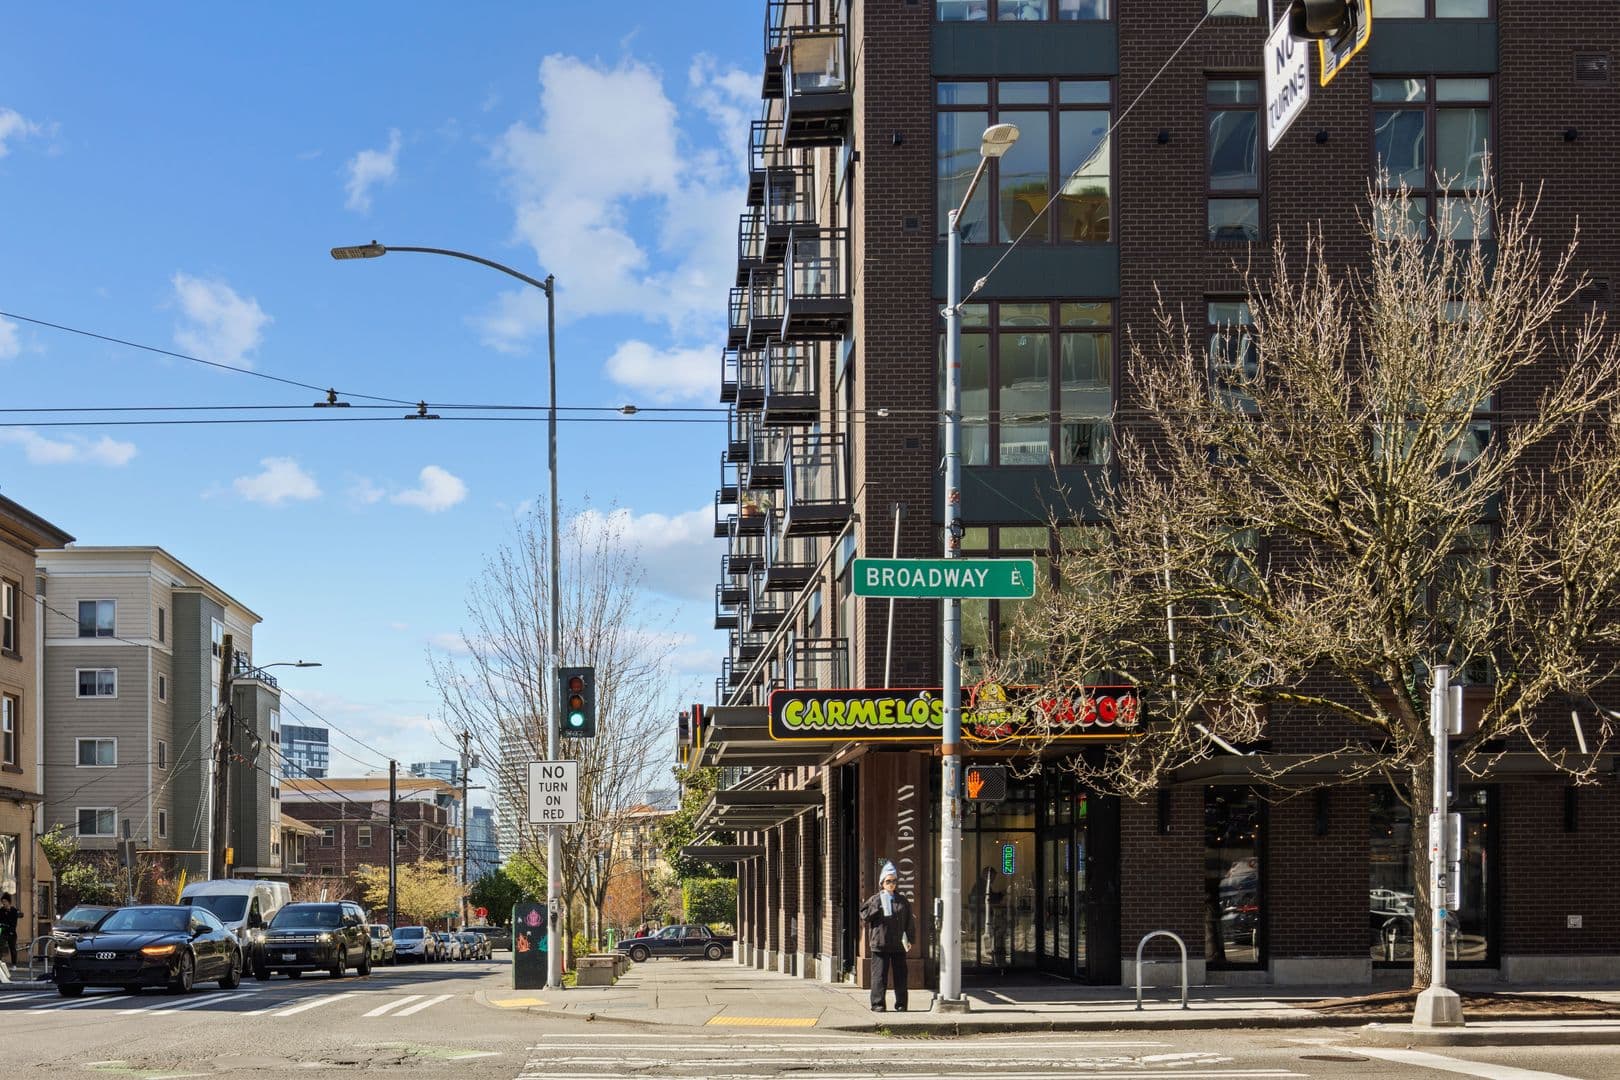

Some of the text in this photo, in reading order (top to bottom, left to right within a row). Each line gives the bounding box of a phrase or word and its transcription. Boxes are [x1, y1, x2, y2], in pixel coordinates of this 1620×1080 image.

[1275, 32, 1295, 76] NO
[1269, 63, 1306, 129] TURNS
[866, 567, 1021, 588] BROADWAY E
[783, 690, 943, 730] CARMELO'S
[542, 766, 565, 779] NO
[539, 782, 568, 793] TURN
[545, 795, 561, 806] ON
[543, 809, 565, 820] RED
